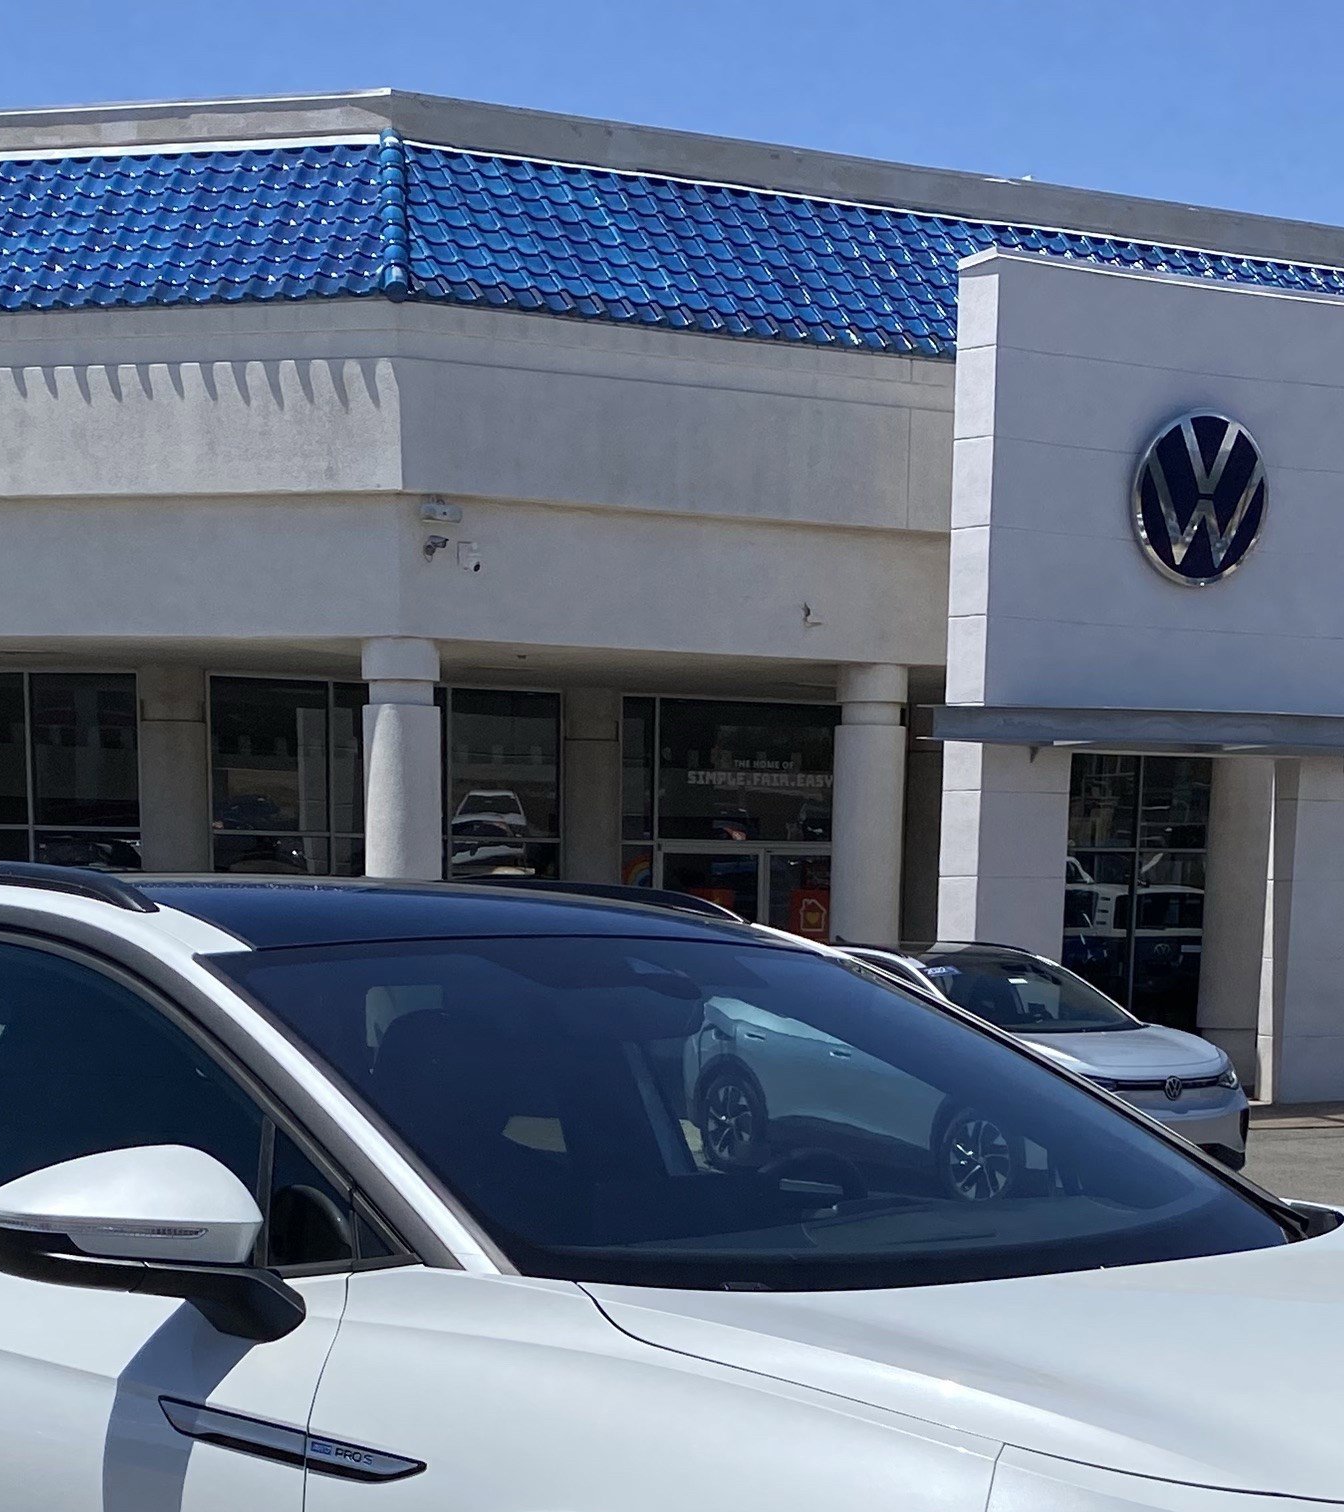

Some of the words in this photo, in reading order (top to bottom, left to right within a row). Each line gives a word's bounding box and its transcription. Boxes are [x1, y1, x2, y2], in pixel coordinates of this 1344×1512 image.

[734, 759, 750, 768] THE
[753, 760, 780, 769] HOME
[335, 1447, 362, 1463] PRO
[363, 1454, 374, 1466] S
